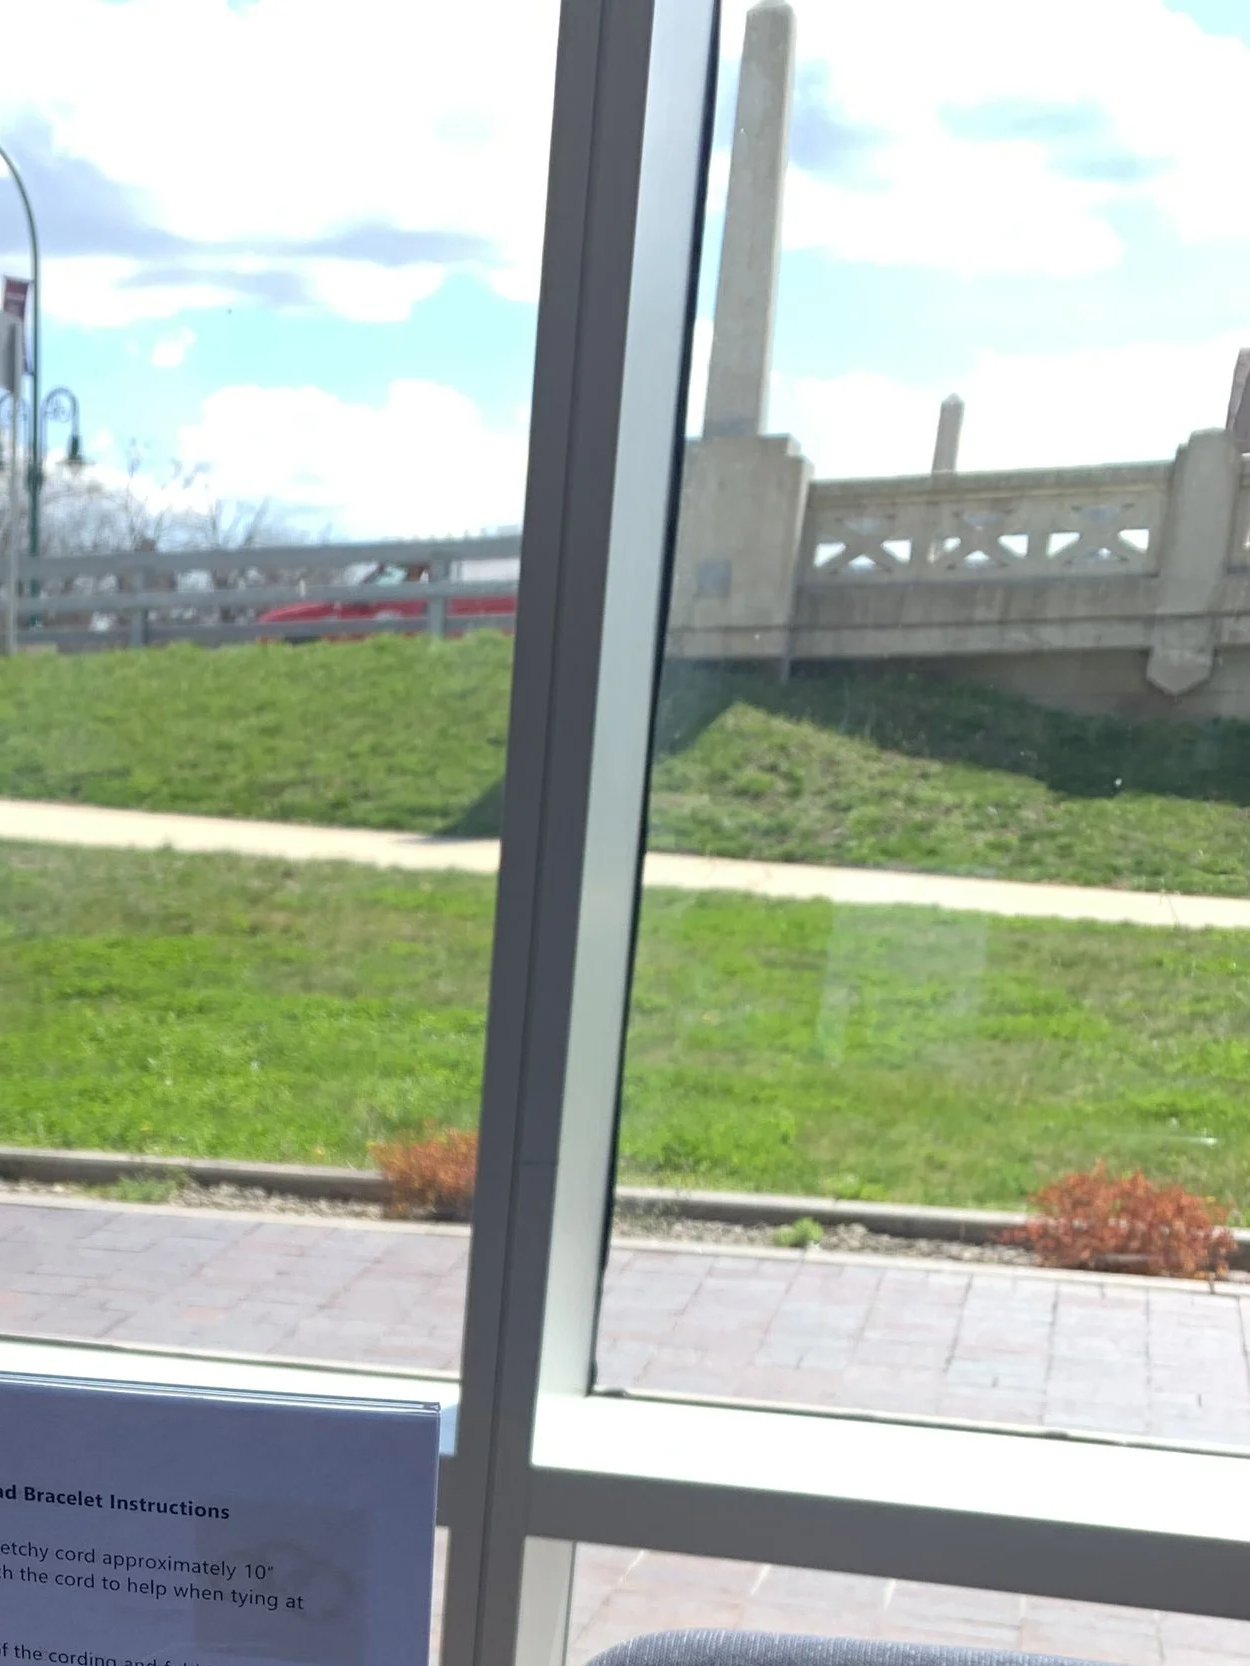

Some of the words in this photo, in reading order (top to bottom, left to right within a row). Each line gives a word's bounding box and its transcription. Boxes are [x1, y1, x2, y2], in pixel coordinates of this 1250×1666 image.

[24, 1486, 103, 1508] Bracelet
[111, 1495, 230, 1519] Instructions
[55, 1548, 95, 1563] cord
[103, 1551, 236, 1580] approximately
[20, 1568, 48, 1583] the
[55, 1572, 95, 1589] cord
[102, 1576, 120, 1591] to
[128, 1578, 166, 1599] help
[174, 1583, 223, 1601] when
[231, 1589, 278, 1610] tying
[286, 1595, 303, 1609] at
[14, 1644, 42, 1661] the
